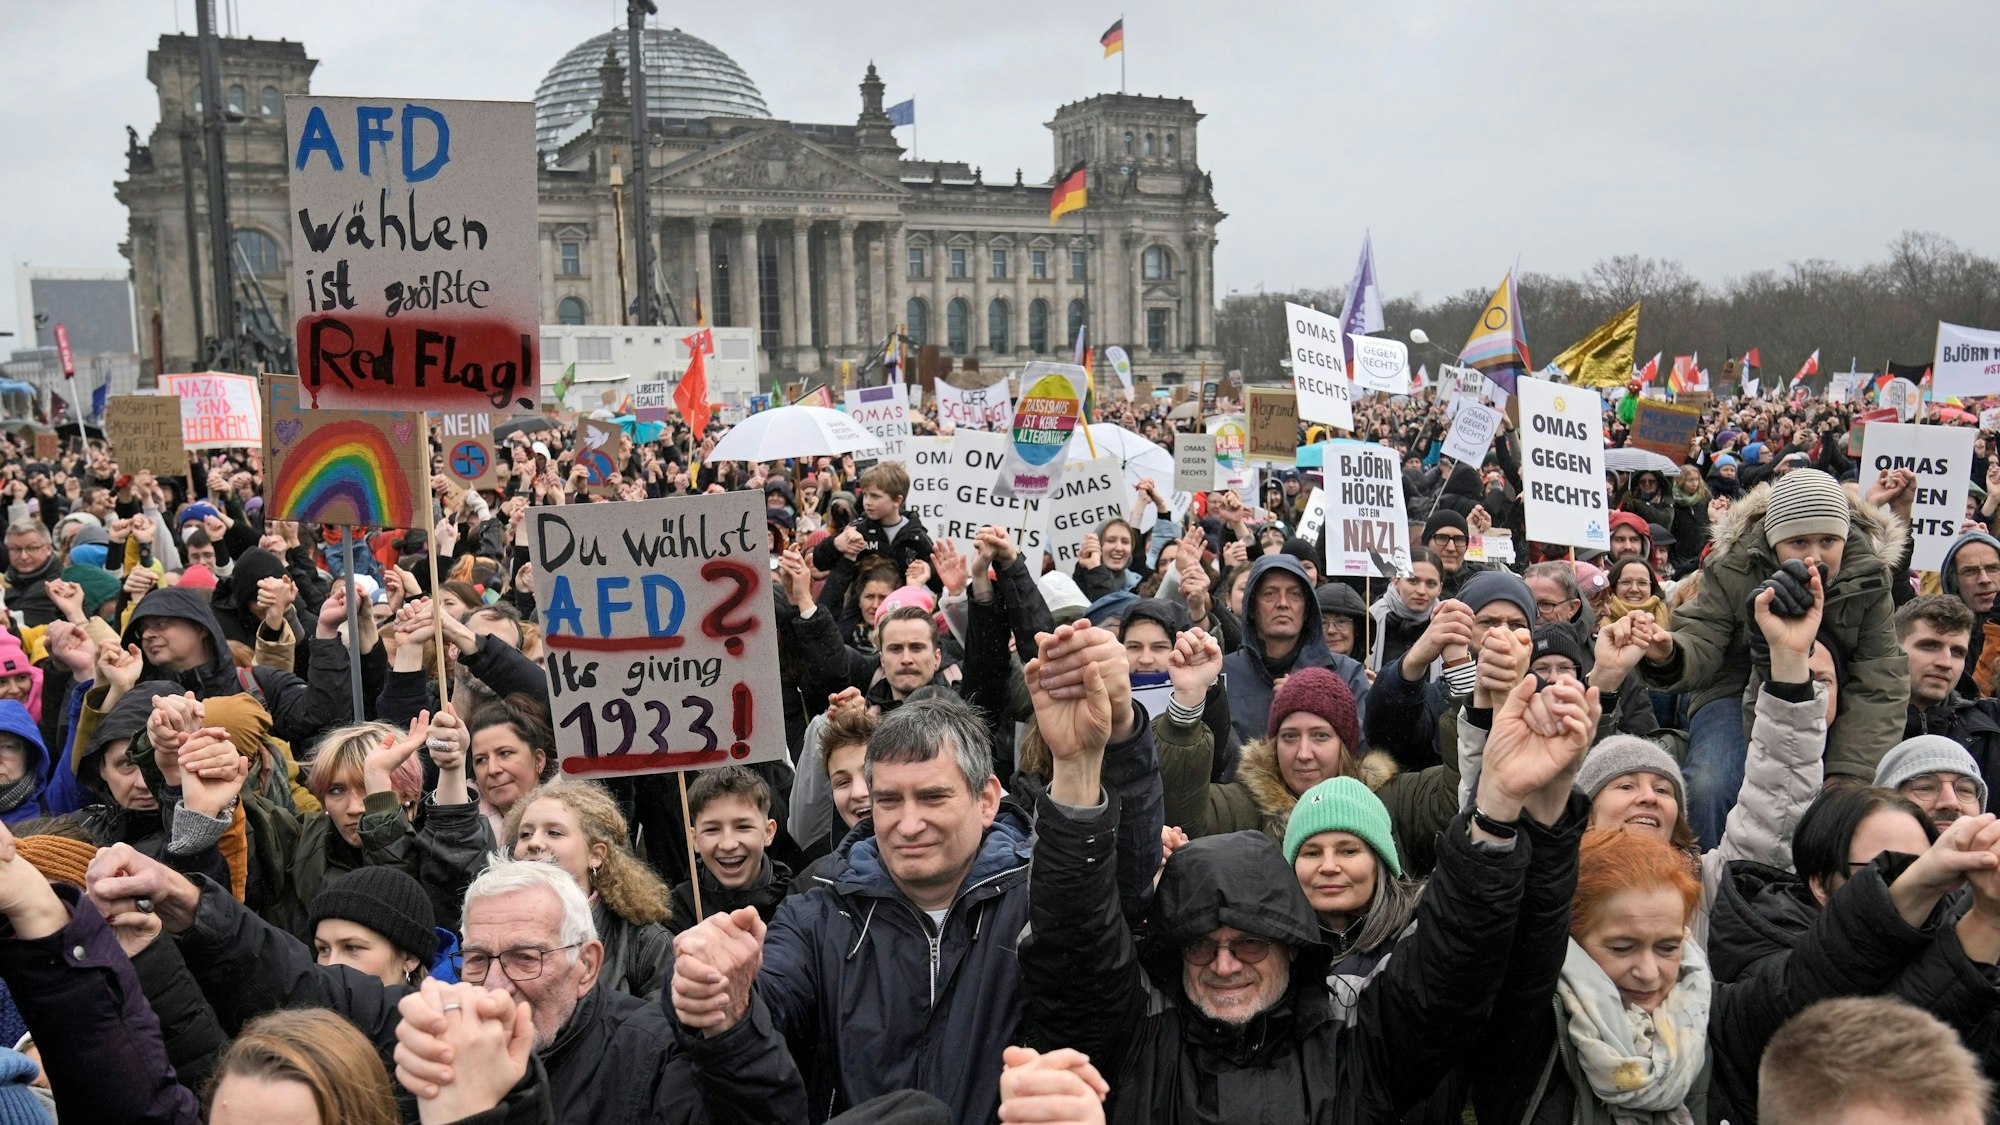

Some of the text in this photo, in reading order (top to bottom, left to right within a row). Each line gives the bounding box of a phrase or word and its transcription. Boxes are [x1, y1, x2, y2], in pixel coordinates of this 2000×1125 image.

[296, 104, 450, 183] AFD
[298, 188, 488, 254] wählen
[306, 258, 490, 317] ist größte
[1296, 320, 1336, 343] OMAS
[1297, 348, 1342, 372] GEGEN
[1363, 345, 1397, 359] GEGEN
[1943, 344, 1989, 362] BJÖRN
[310, 318, 535, 410] Red Flag!
[1362, 357, 1400, 371] RECHTS
[178, 380, 226, 399] NAZIS
[960, 390, 988, 407] WER
[1298, 376, 1348, 401] RECHTS
[852, 406, 904, 424] OMAS
[1023, 398, 1070, 415] RASSISMUS
[1467, 408, 1490, 424] OMAS
[185, 414, 251, 441] HARAM
[866, 422, 908, 438] EGEN
[1022, 414, 1038, 428] IST
[1462, 417, 1488, 433] GEGEN
[1532, 414, 1588, 441] OMAS
[1017, 429, 1068, 446] ALTERNATIVE
[1458, 424, 1486, 441] RECHTS
[916, 451, 953, 465] OM
[965, 449, 1004, 471] OM
[1340, 451, 1393, 480] BJÖRN
[1531, 447, 1592, 475] GEGEN
[1875, 455, 1949, 475] OMAS
[913, 478, 949, 492] GEG
[1341, 478, 1394, 508] HÖCKE
[1531, 481, 1601, 509] RECHTS
[1054, 503, 1122, 530] GEGEN
[1358, 508, 1380, 518] IST EIN
[538, 511, 757, 573] Du wählst
[1342, 518, 1395, 555] NAZI
[547, 651, 722, 697] Its giving
